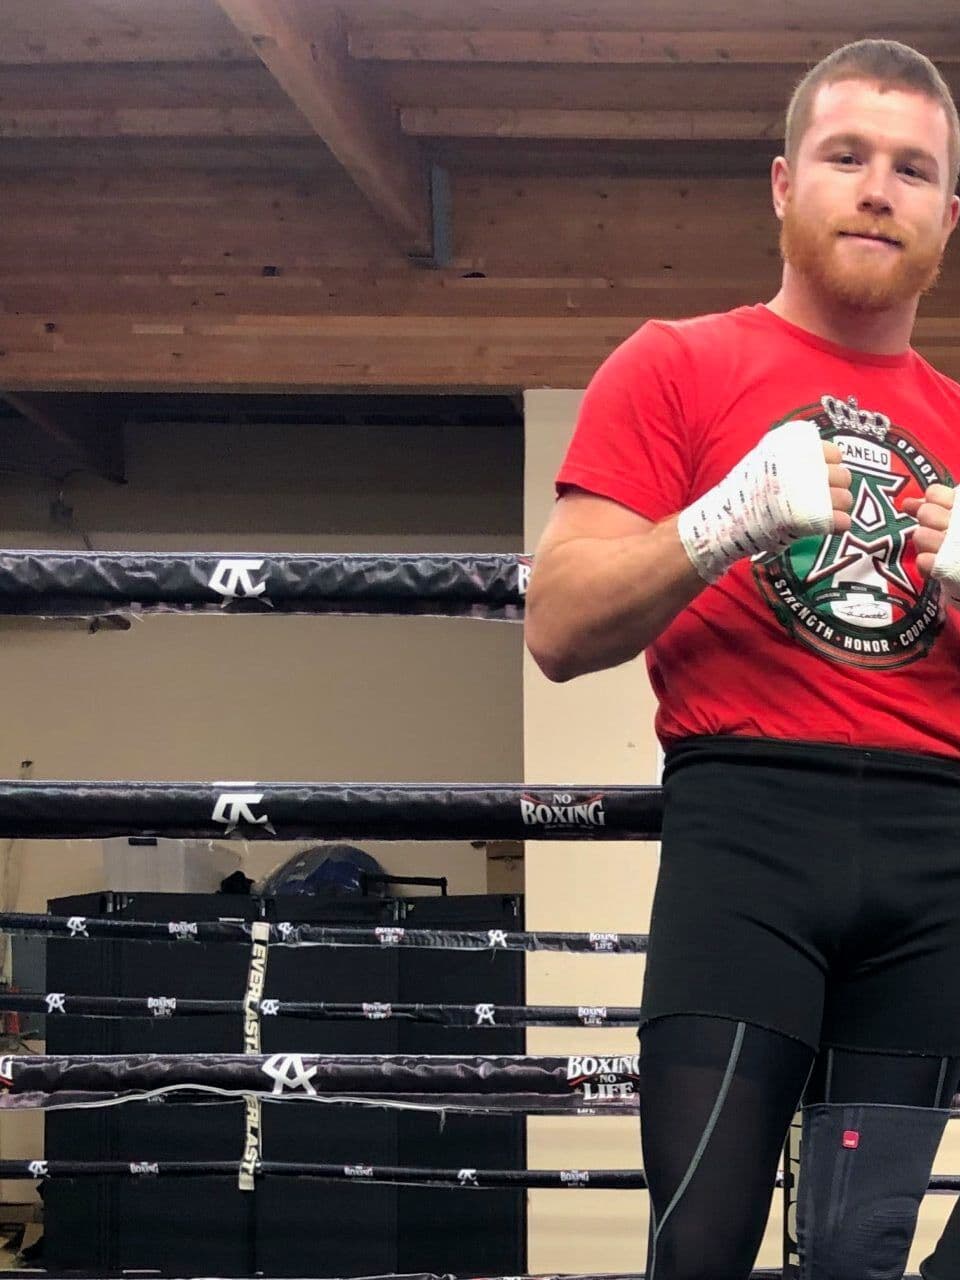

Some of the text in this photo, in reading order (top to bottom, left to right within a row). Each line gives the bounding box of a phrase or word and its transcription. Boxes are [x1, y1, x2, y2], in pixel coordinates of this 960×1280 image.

[897, 440, 938, 483] OF BOX
[774, 579, 834, 640] STRENGTH
[844, 636, 890, 652] HONOR
[900, 600, 937, 646] COURAGE
[520, 799, 605, 826] BOXING
[553, 794, 571, 804] NO
[244, 943, 267, 1050] EVERLAST
[582, 1082, 635, 1100] LIFE
[600, 1074, 617, 1083] NO
[242, 1098, 259, 1175] ERLAST
